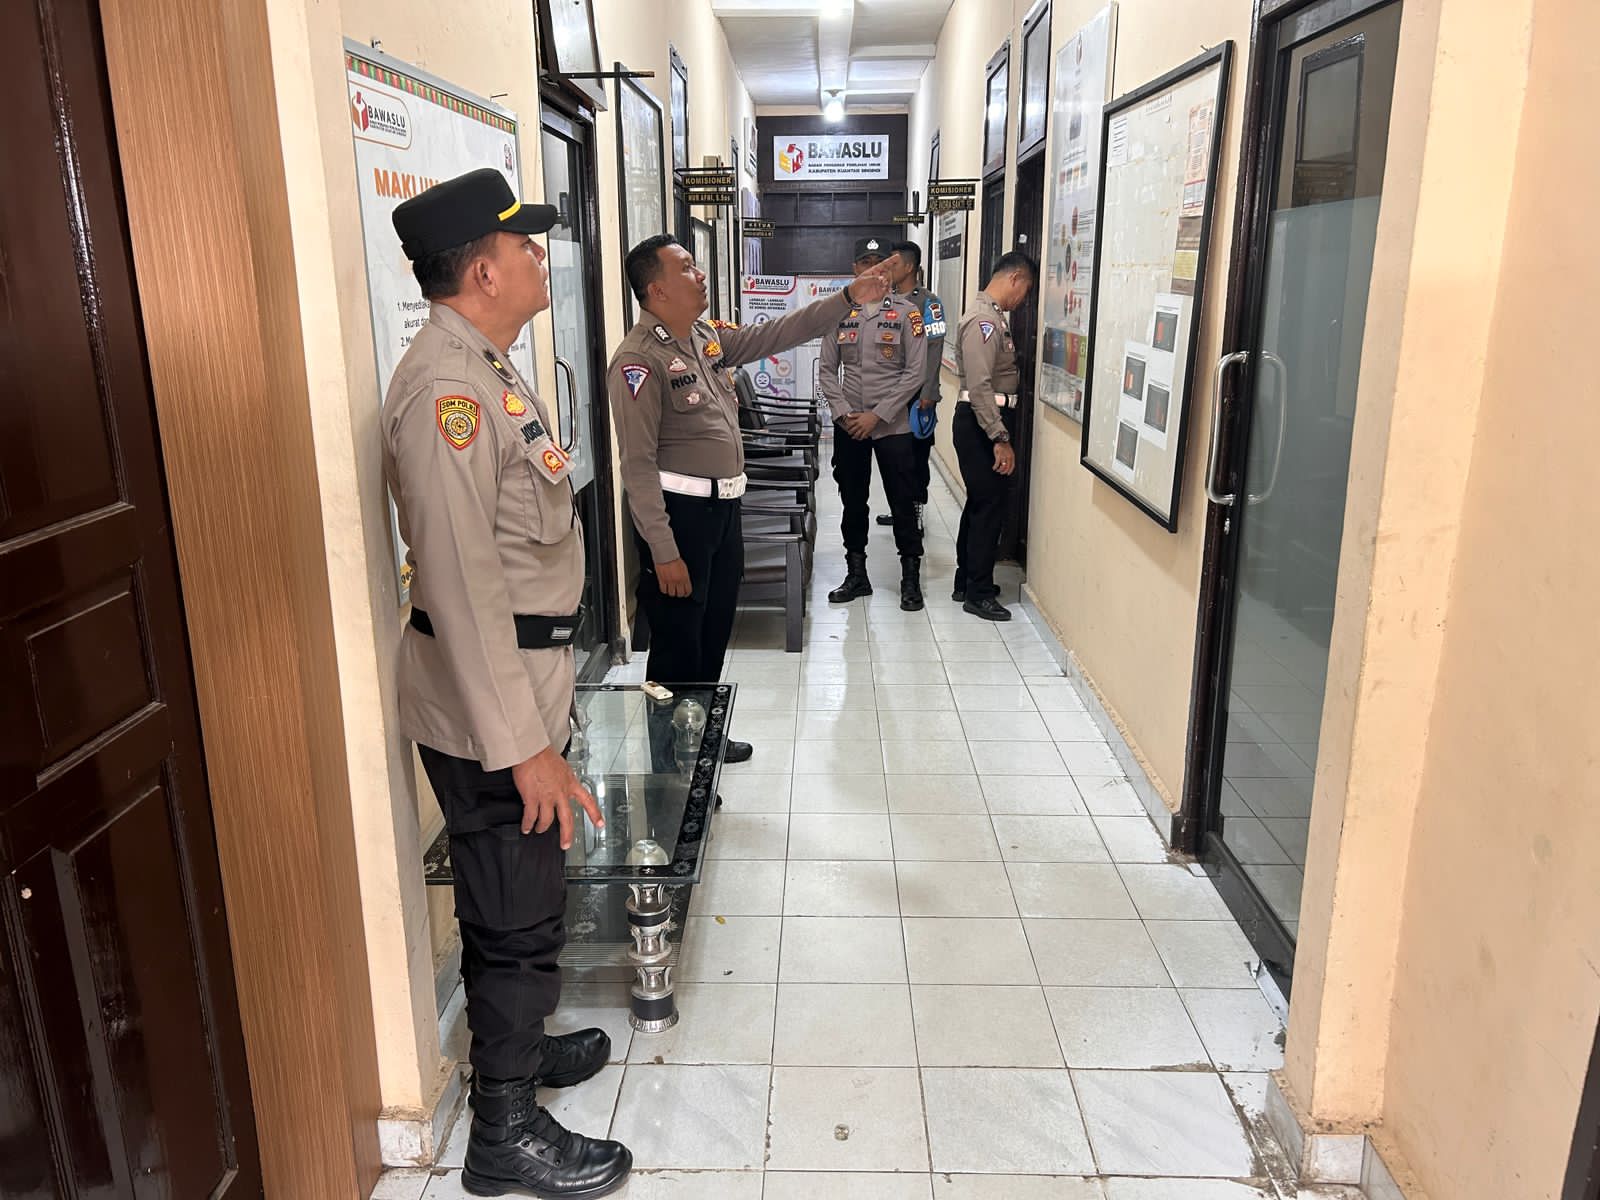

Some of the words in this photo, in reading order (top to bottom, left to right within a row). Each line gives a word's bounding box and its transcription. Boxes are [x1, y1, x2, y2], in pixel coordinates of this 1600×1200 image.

[368, 105, 406, 129] BAWASLU
[808, 142, 882, 159] BAWASLU
[685, 176, 732, 185] KOMISIONER
[930, 186, 973, 194] KOMISIONER
[755, 278, 790, 286] BAWASLU
[877, 321, 901, 329] POLRI
[442, 400, 456, 409] SDM
[457, 400, 476, 413] POLRI
